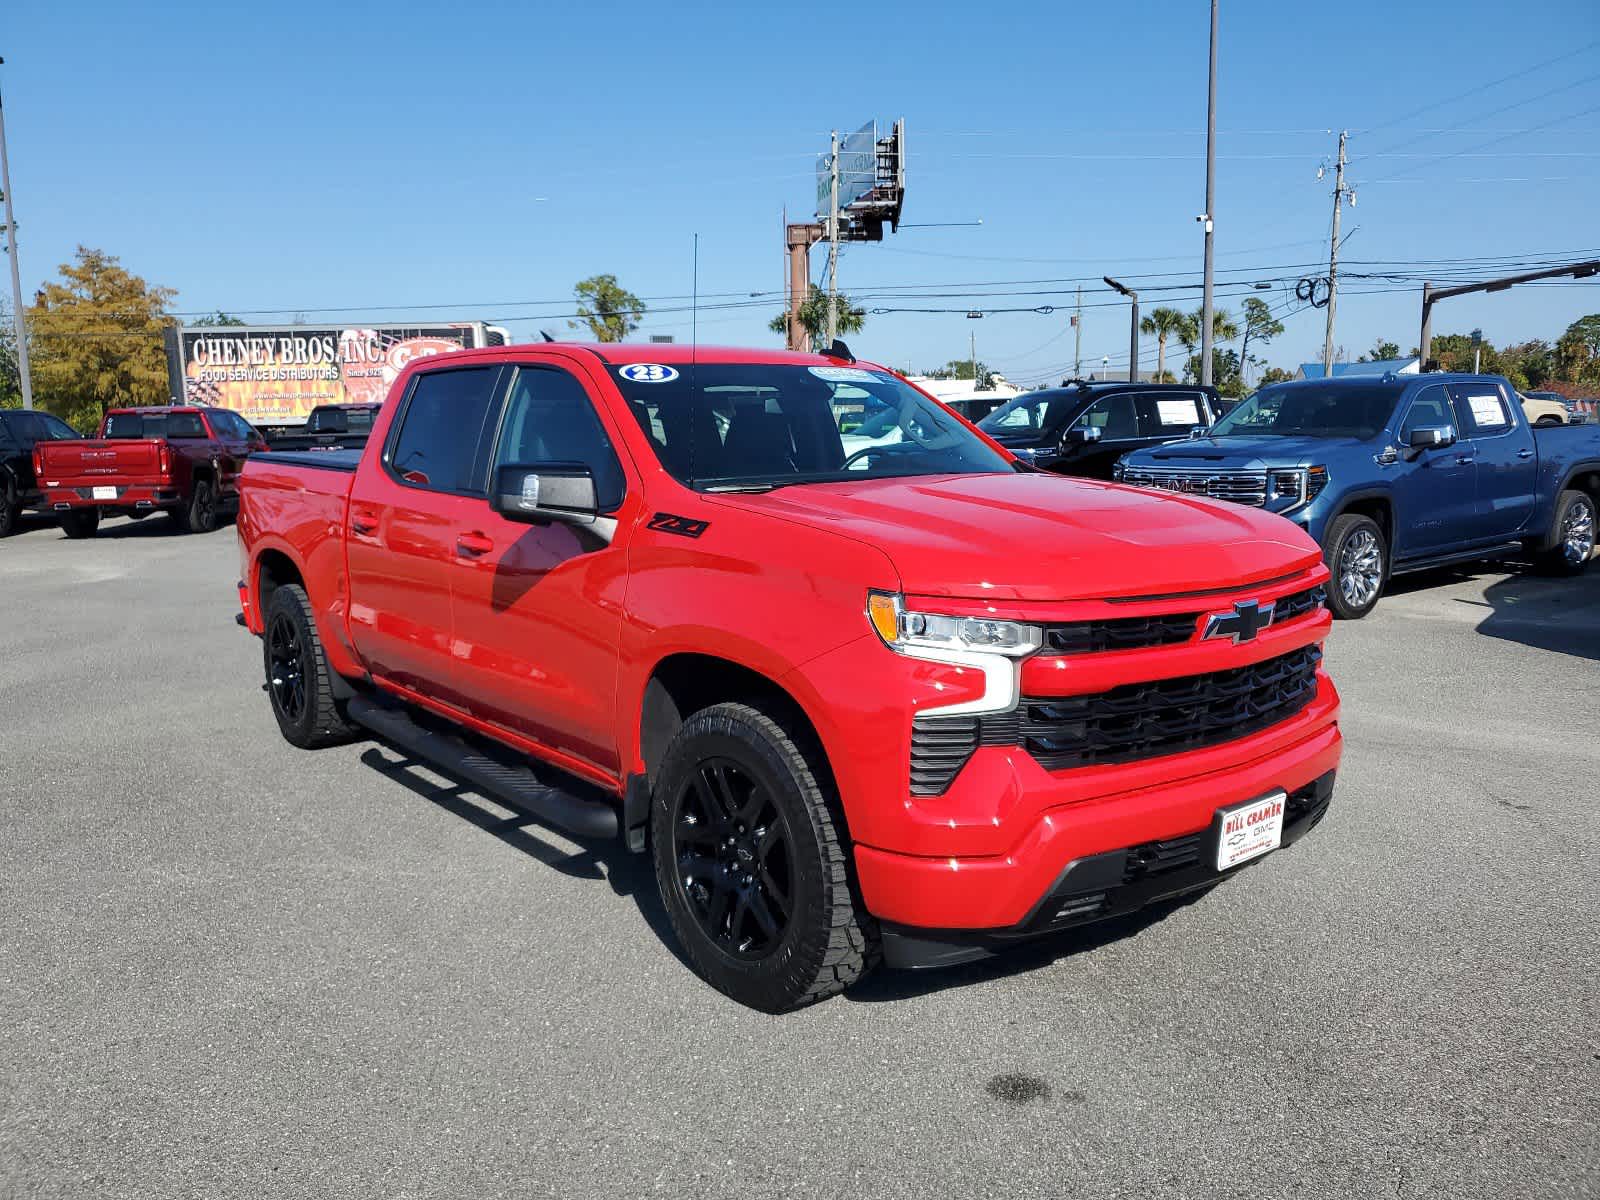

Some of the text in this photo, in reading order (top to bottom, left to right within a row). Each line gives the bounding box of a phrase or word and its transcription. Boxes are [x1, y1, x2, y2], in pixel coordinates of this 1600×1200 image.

[193, 338, 276, 364] CHENEY
[279, 336, 340, 364] BROS.
[343, 336, 385, 363] INC.
[200, 366, 338, 381] FOOD SERVICE DISTRIBUTORS
[347, 369, 365, 377] Since
[632, 365, 664, 380] 23
[646, 511, 711, 538] Z71
[1226, 803, 1282, 835] BILL CRAMER
[1253, 822, 1275, 836] GMC
